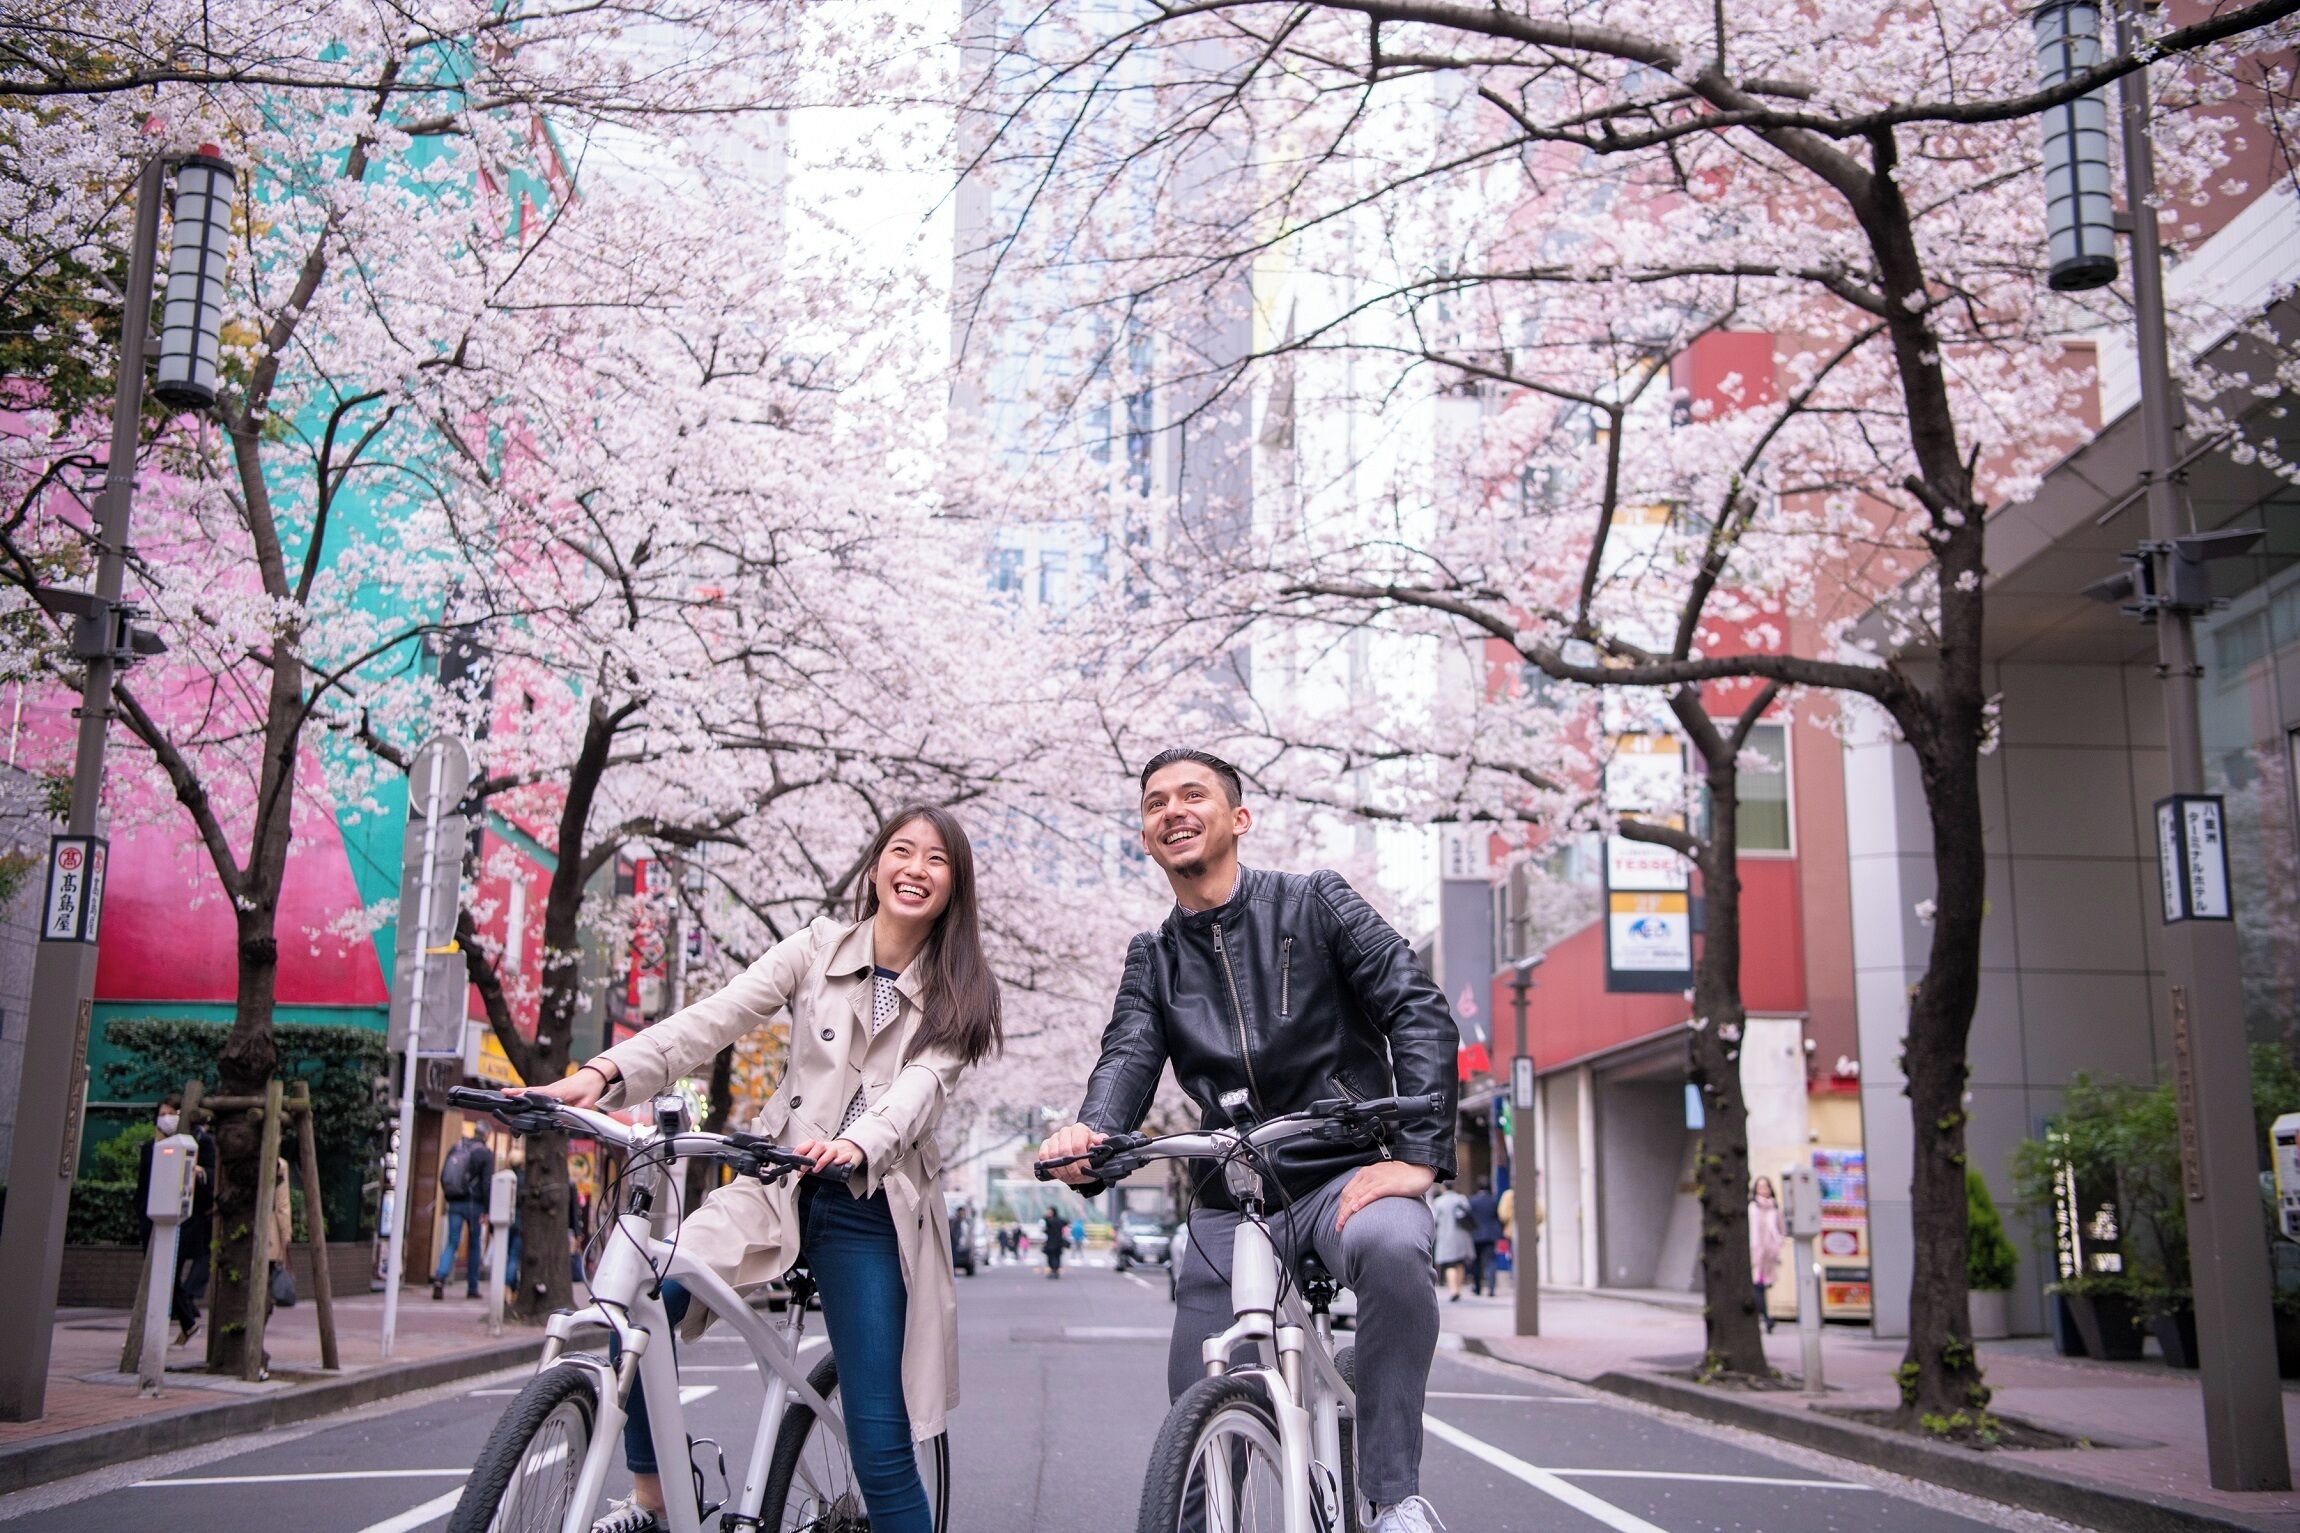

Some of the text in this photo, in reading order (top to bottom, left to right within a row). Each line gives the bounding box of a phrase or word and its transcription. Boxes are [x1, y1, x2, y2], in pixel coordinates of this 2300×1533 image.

[1614, 857, 1682, 871] TESSE
[2189, 812, 2208, 911] ターミナルホテル
